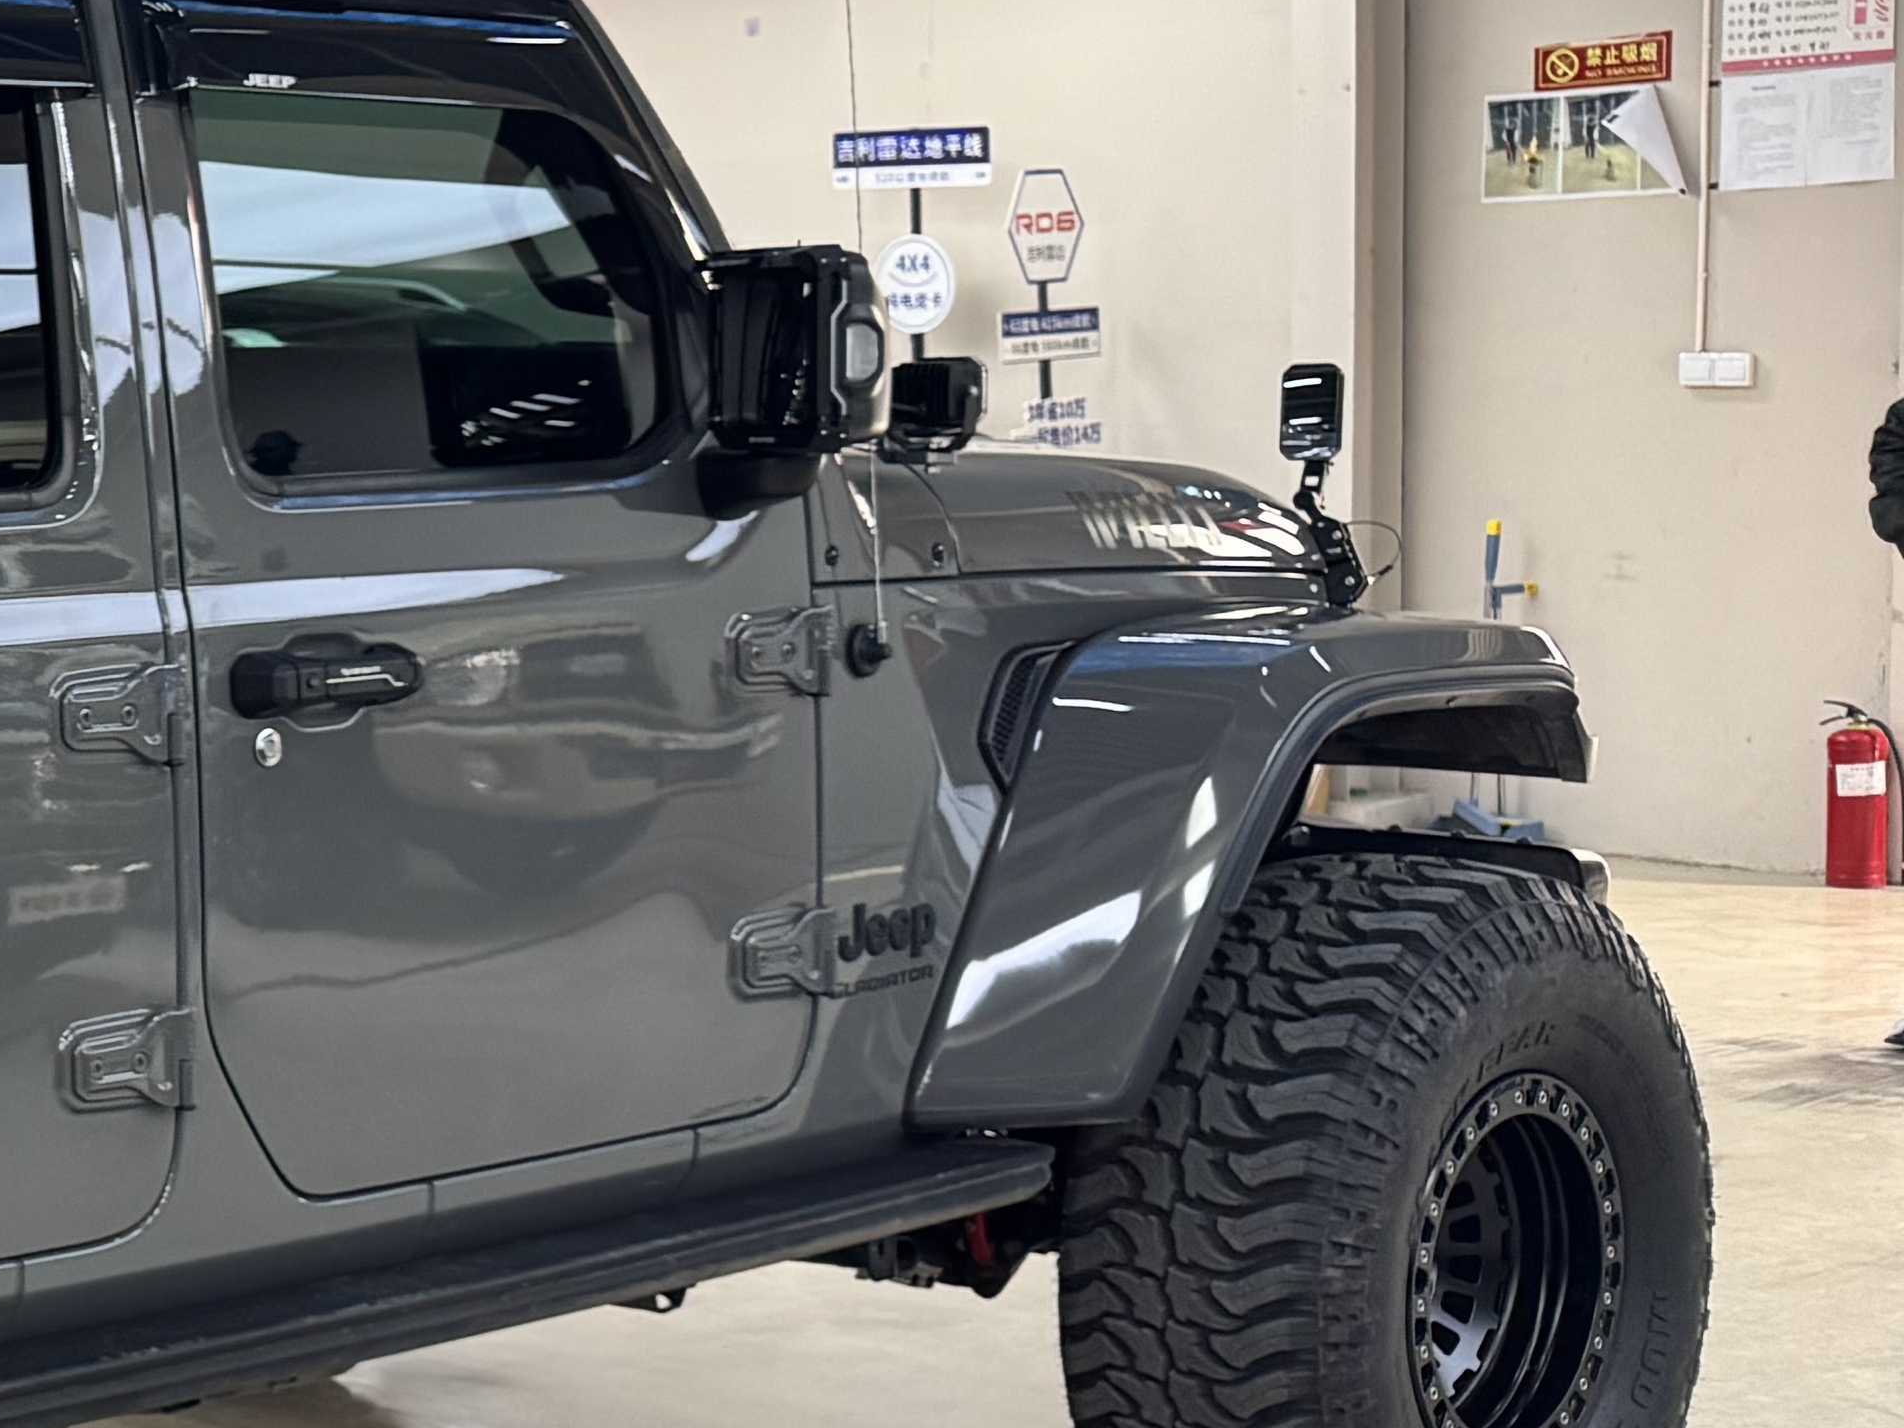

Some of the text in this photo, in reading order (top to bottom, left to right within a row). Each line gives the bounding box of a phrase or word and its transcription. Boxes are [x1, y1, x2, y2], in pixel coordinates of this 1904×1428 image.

[1586, 42, 1658, 67] 禁止吸烟
[243, 73, 298, 89] JEEP
[1015, 211, 1077, 236] RD6
[895, 253, 931, 273] 4X4
[838, 902, 936, 963] Jeep
